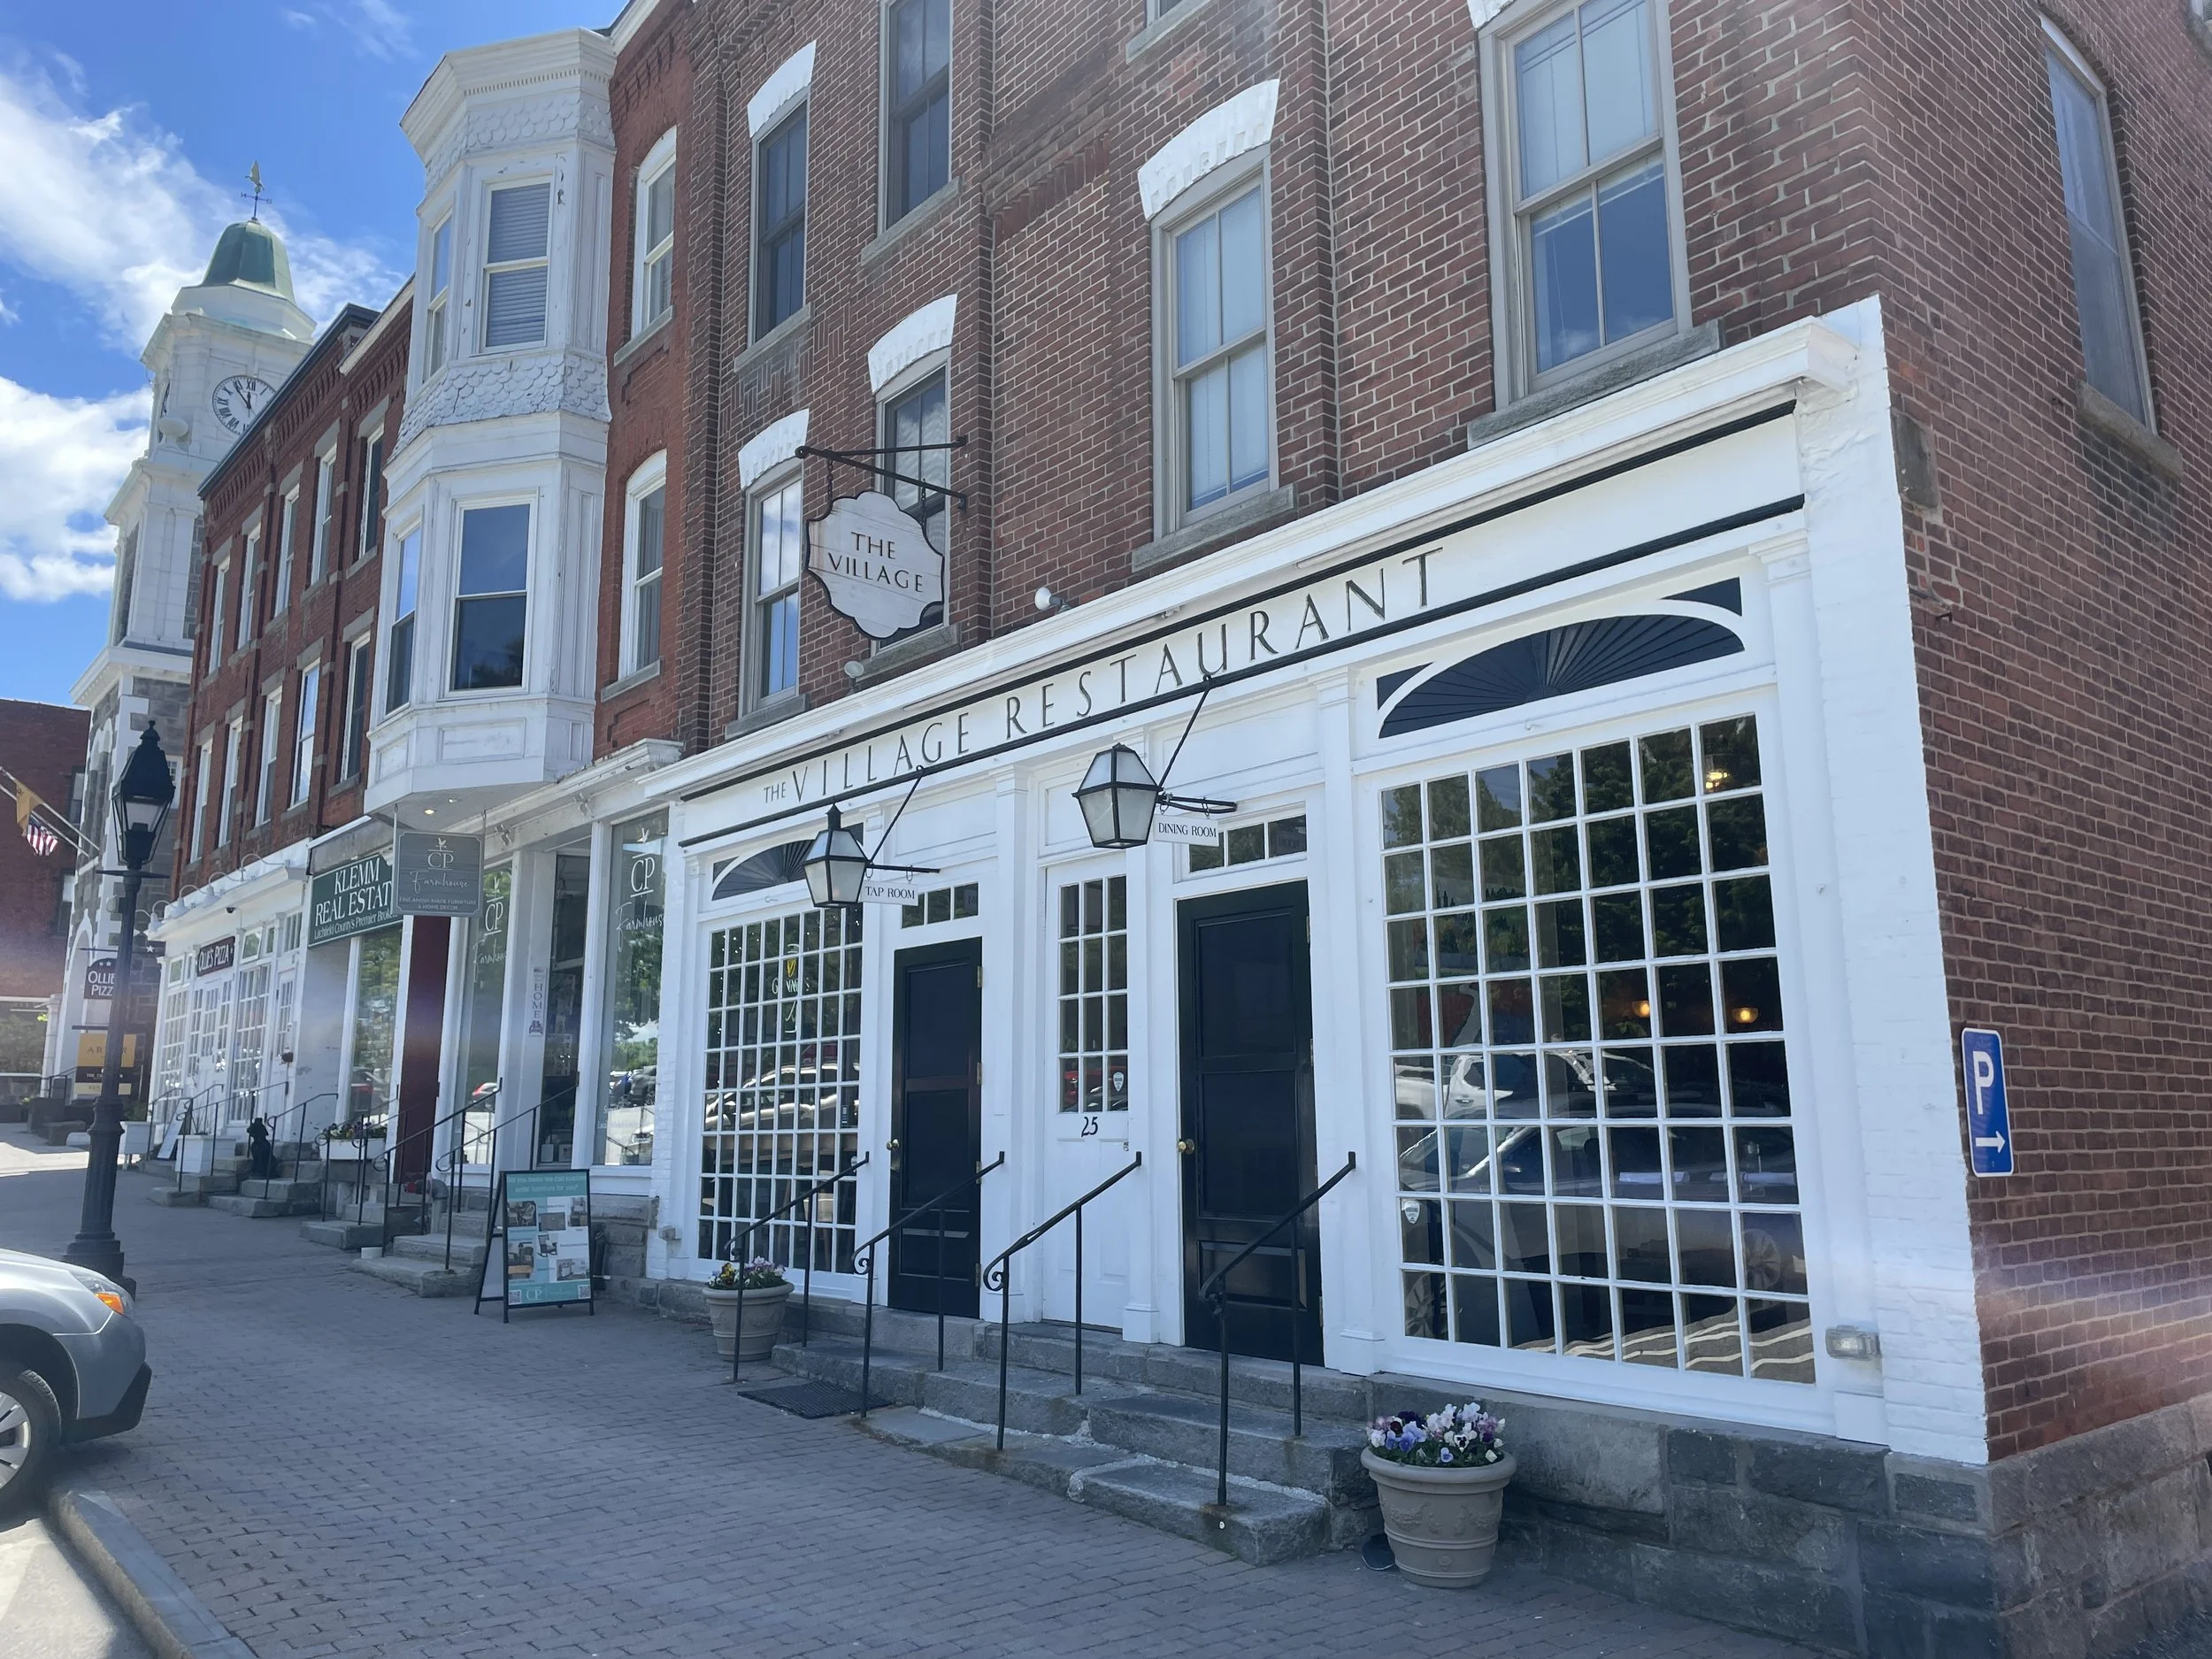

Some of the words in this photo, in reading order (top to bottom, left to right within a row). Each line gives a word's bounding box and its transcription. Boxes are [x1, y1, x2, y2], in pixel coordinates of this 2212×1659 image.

[850, 531, 896, 560] THE
[827, 552, 923, 593] VILLAGE
[764, 781, 787, 803] THE
[792, 711, 970, 803] VILLAGE
[1005, 546, 1444, 740] RESTAURANT
[1158, 822, 1188, 835] DINING
[1191, 825, 1217, 838] ROOM
[334, 856, 380, 895] KLEMM
[427, 851, 455, 869] CP
[631, 856, 655, 893] CP
[315, 896, 346, 927] REAL
[348, 880, 393, 917] ESTAT
[864, 886, 884, 897] TAP
[887, 887, 915, 900] ROOM
[485, 901, 504, 933] CP
[615, 899, 664, 953] Farmhous
[88, 971, 115, 985] OLLIE
[91, 985, 113, 996] PIZZ
[1972, 1050, 1995, 1115] P
[1080, 1116, 1099, 1138] 25
